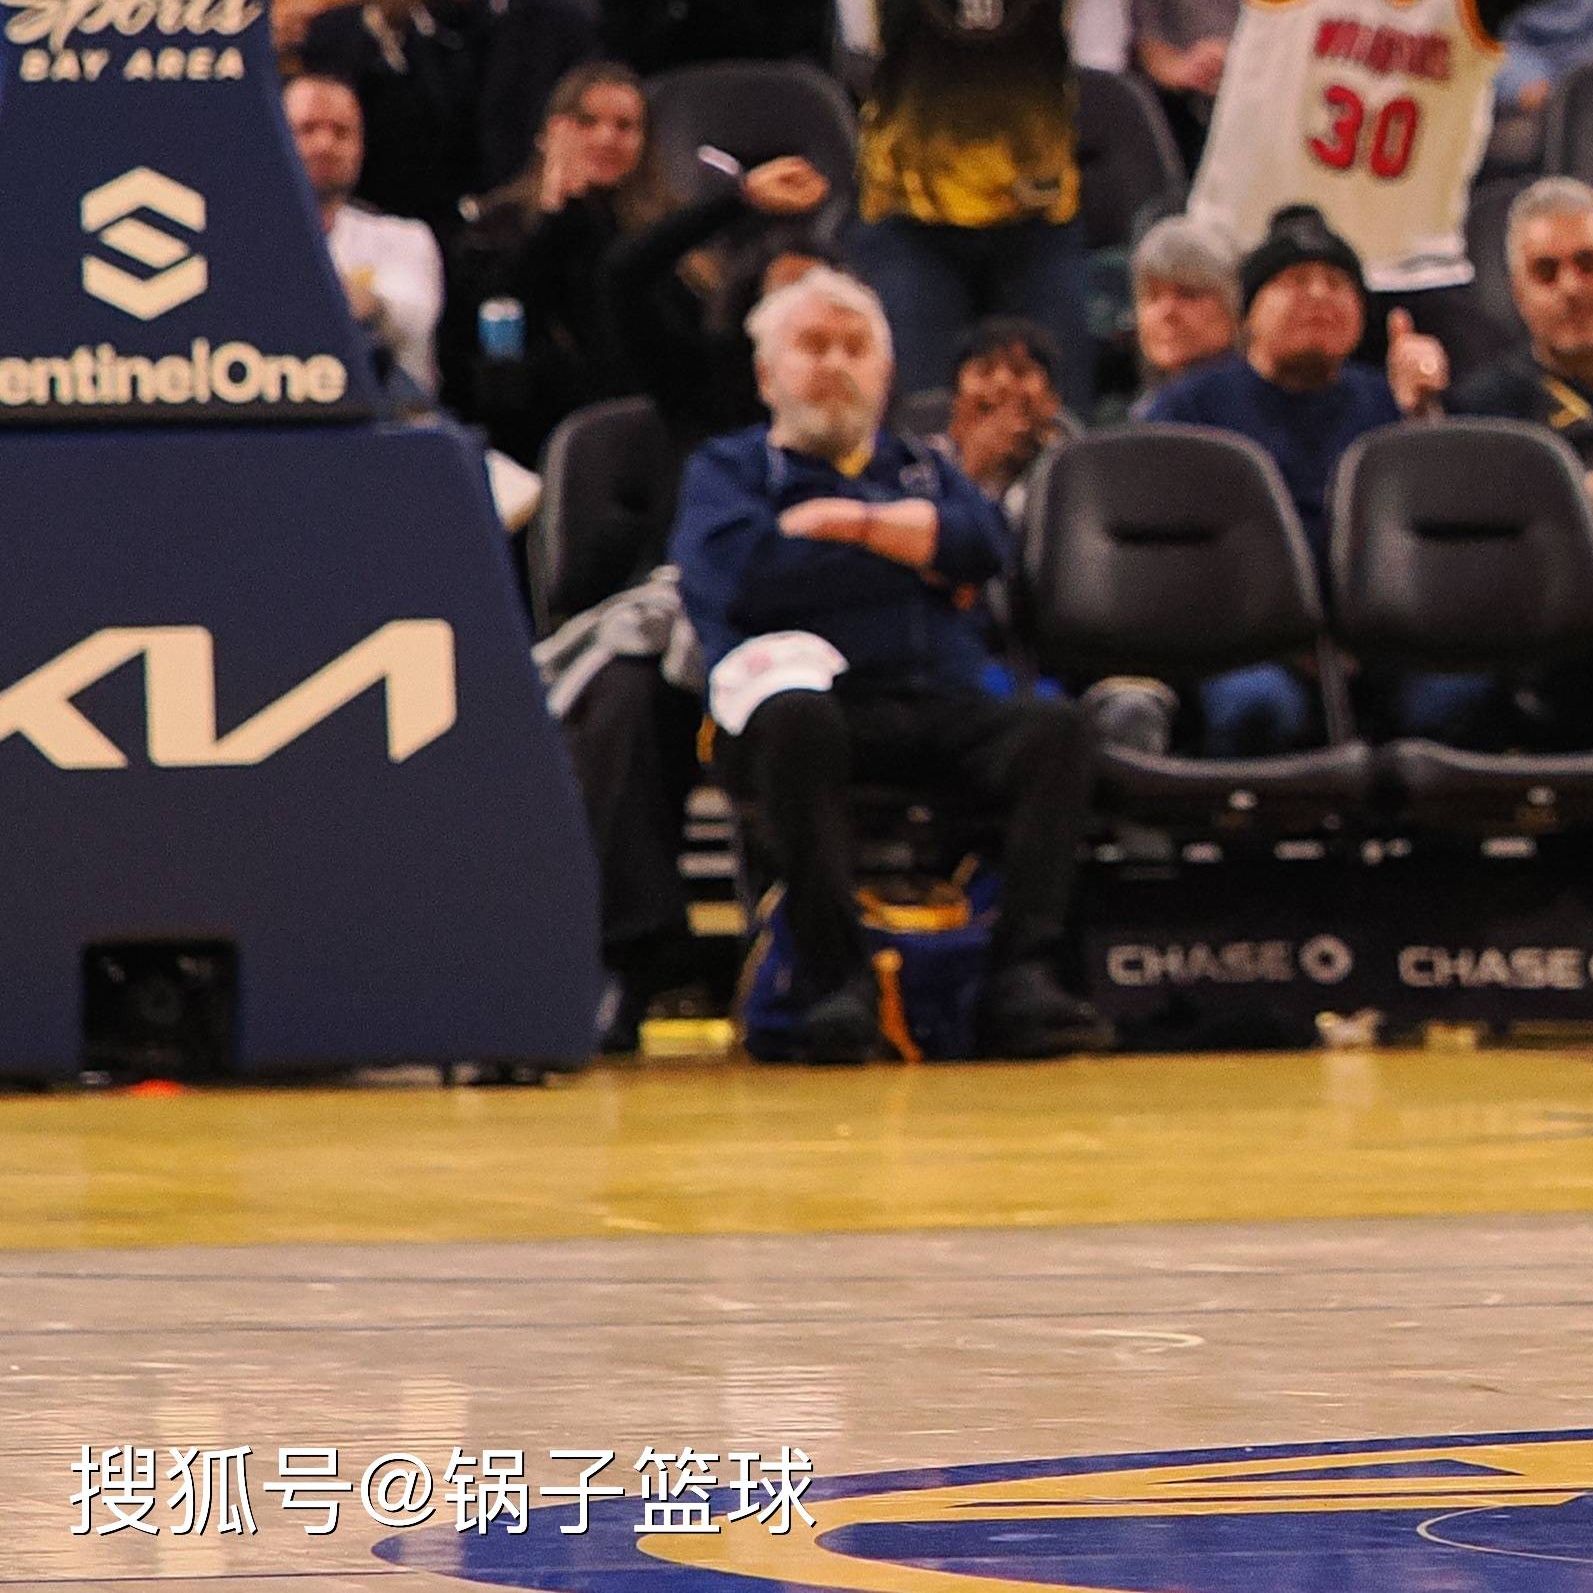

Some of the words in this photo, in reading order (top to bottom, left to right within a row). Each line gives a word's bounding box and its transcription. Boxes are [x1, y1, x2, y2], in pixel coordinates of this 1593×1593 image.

[19, 48, 110, 82] BAY
[122, 47, 246, 81] AREA
[1308, 83, 1420, 180] 30
[1106, 940, 1295, 987] CHASE
[1398, 945, 1583, 989] CHASE
